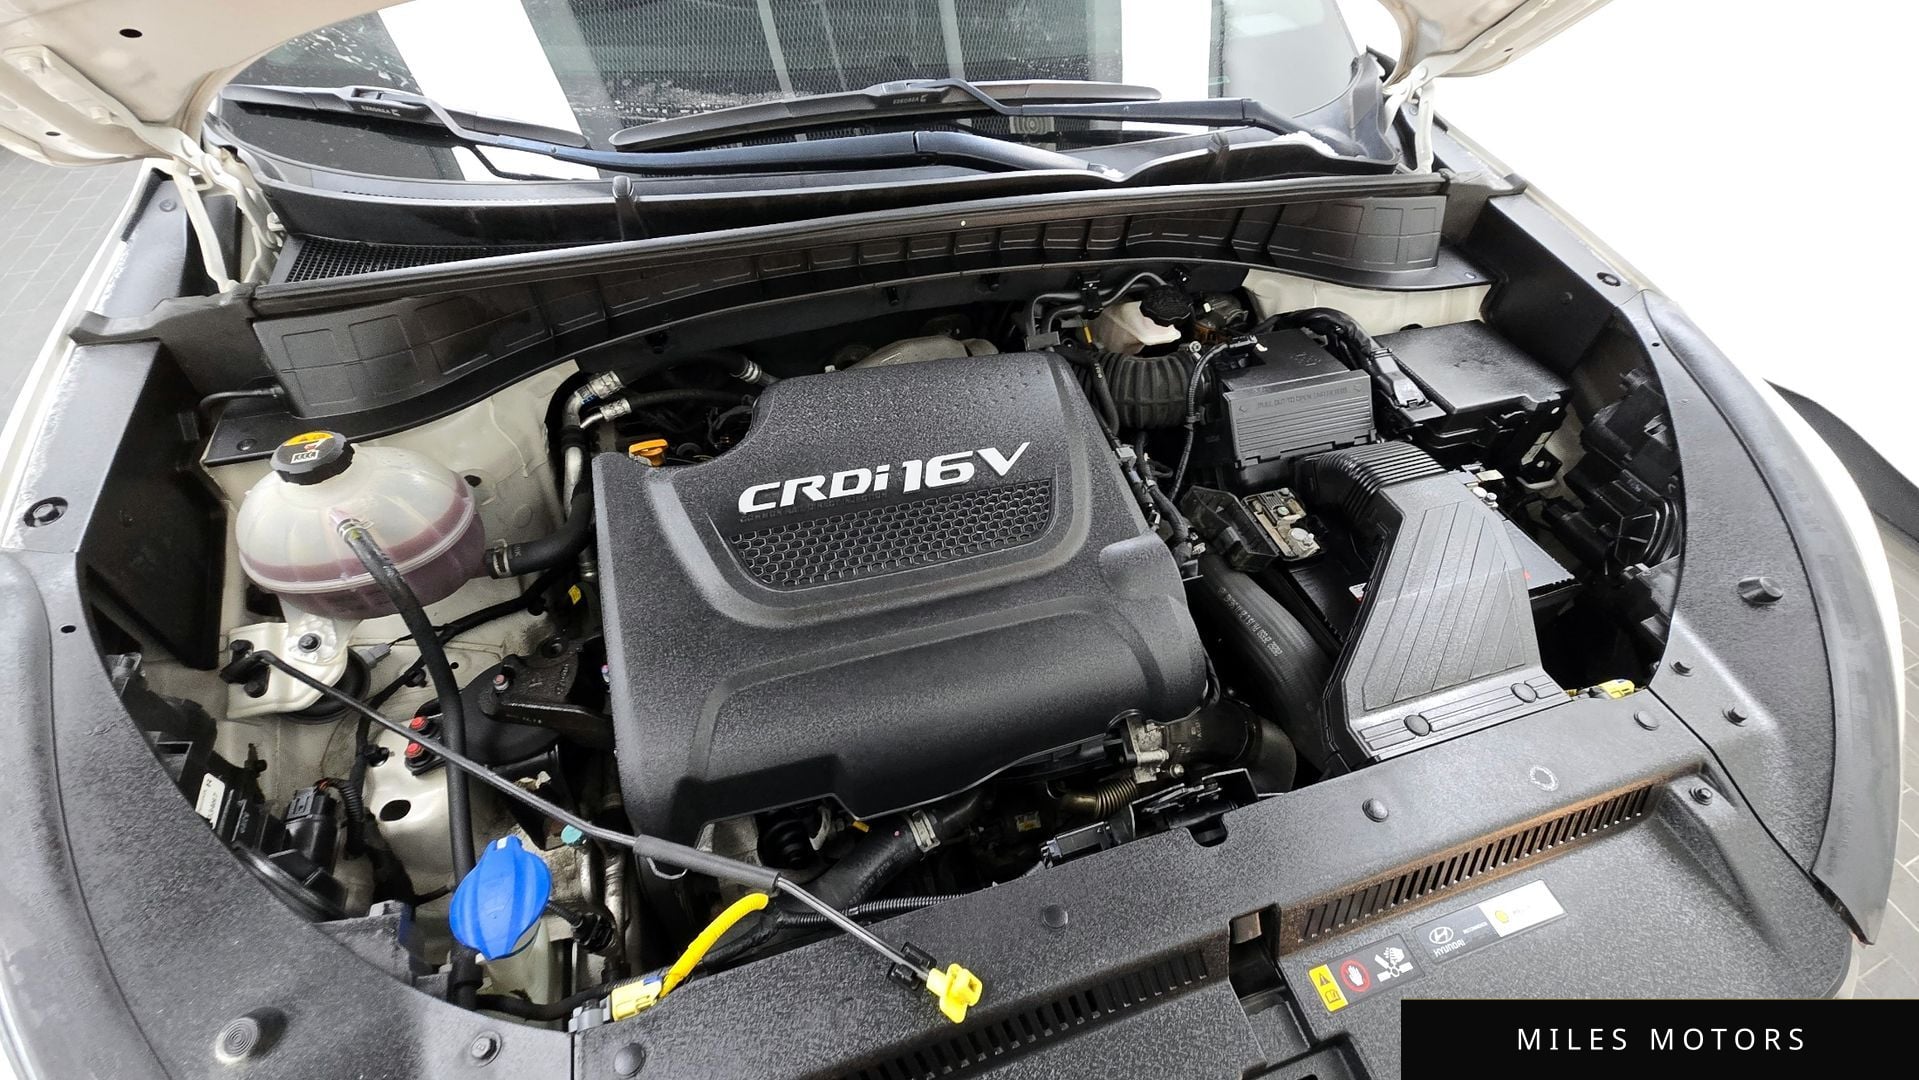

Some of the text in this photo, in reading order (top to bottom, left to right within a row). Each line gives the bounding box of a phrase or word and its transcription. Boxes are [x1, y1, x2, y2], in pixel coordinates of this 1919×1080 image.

[738, 441, 1031, 515] CRDi 16V
[1433, 938, 1466, 958] HYUNDAI
